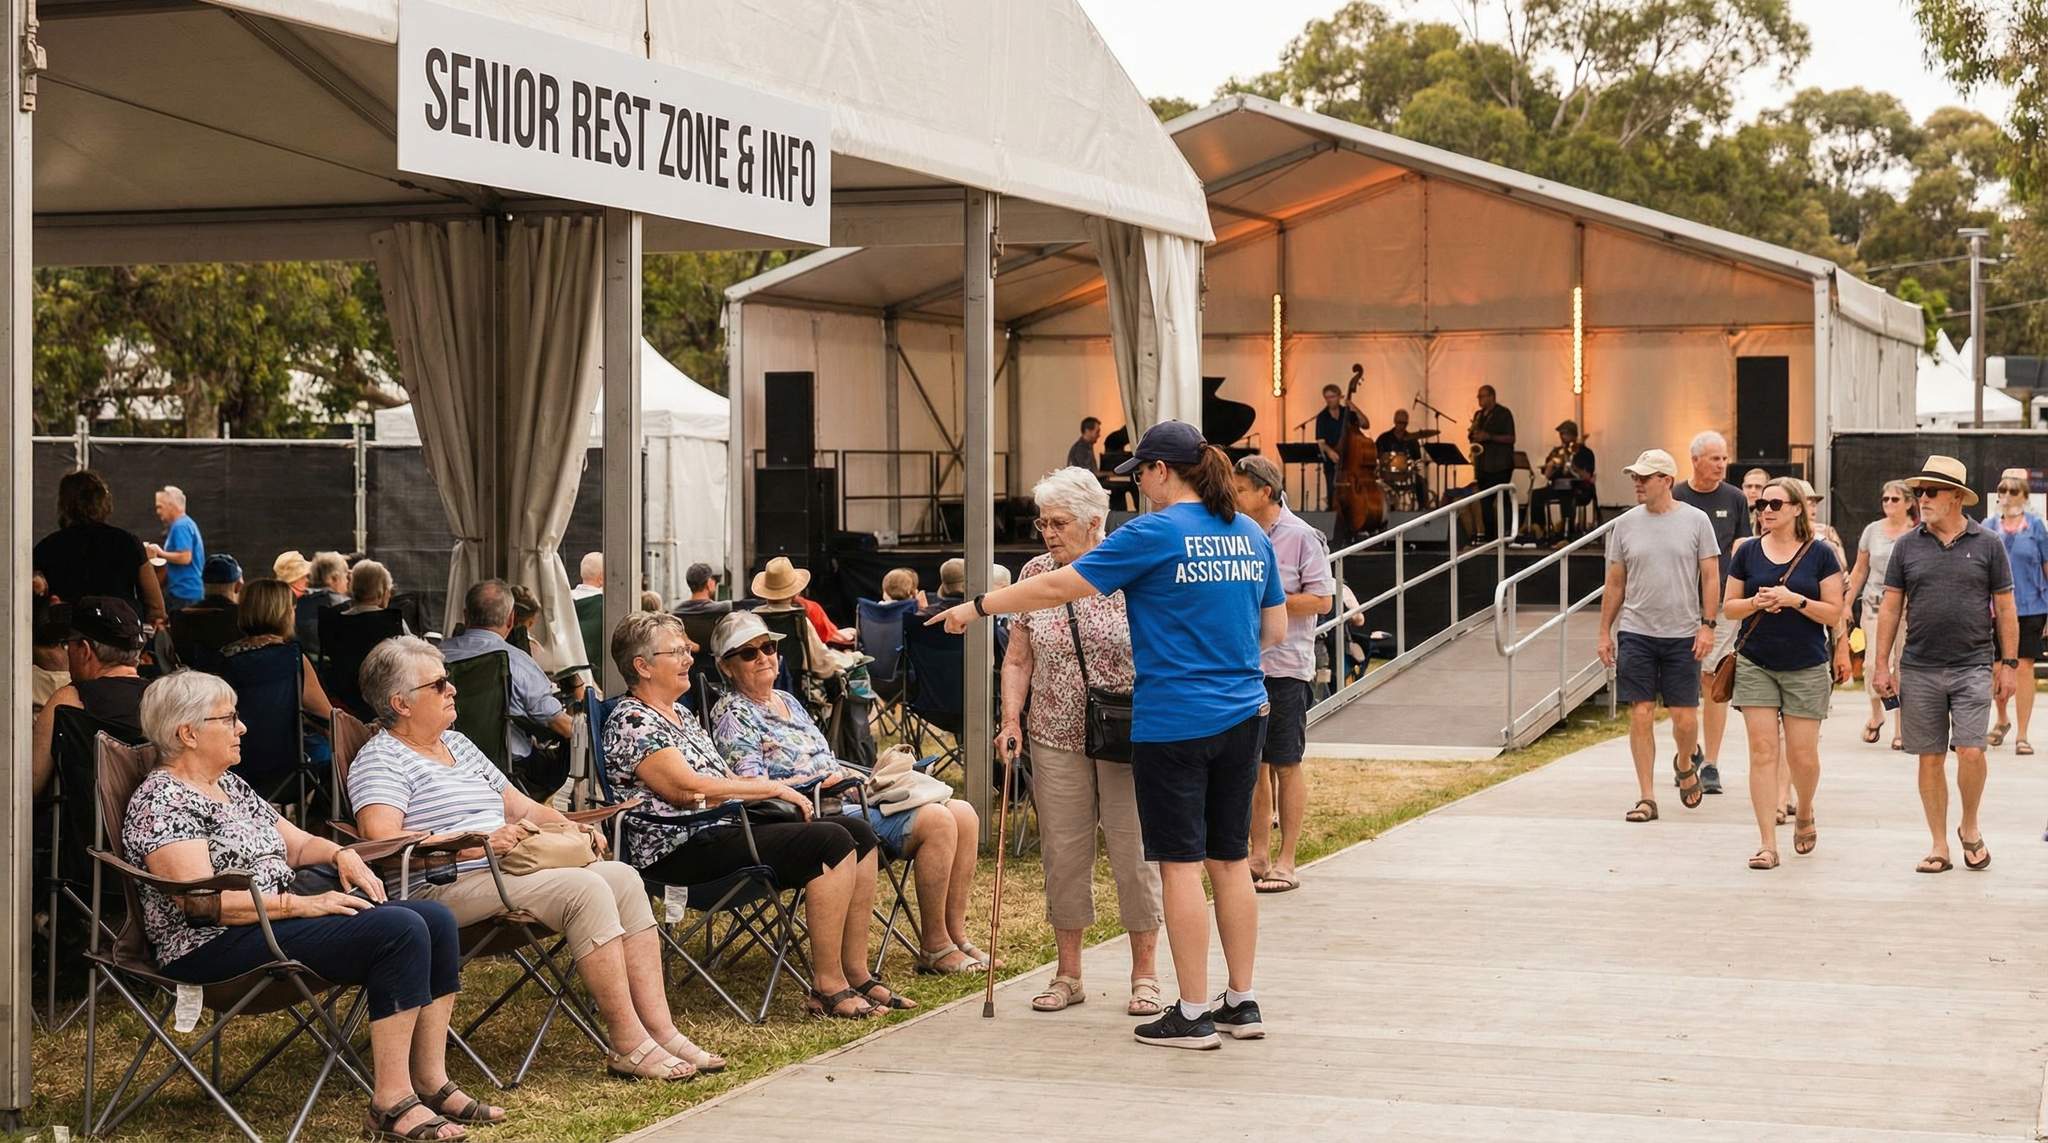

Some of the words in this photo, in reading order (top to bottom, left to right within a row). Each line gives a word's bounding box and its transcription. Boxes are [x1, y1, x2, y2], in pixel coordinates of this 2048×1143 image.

[425, 47, 560, 155] SENIOR
[572, 80, 651, 171] REST
[658, 102, 730, 189] ZONE
[737, 124, 755, 195] &
[761, 129, 816, 207] INFO
[1184, 535, 1256, 558] FESTIVAL
[1175, 559, 1265, 584] ASSISTANCE
